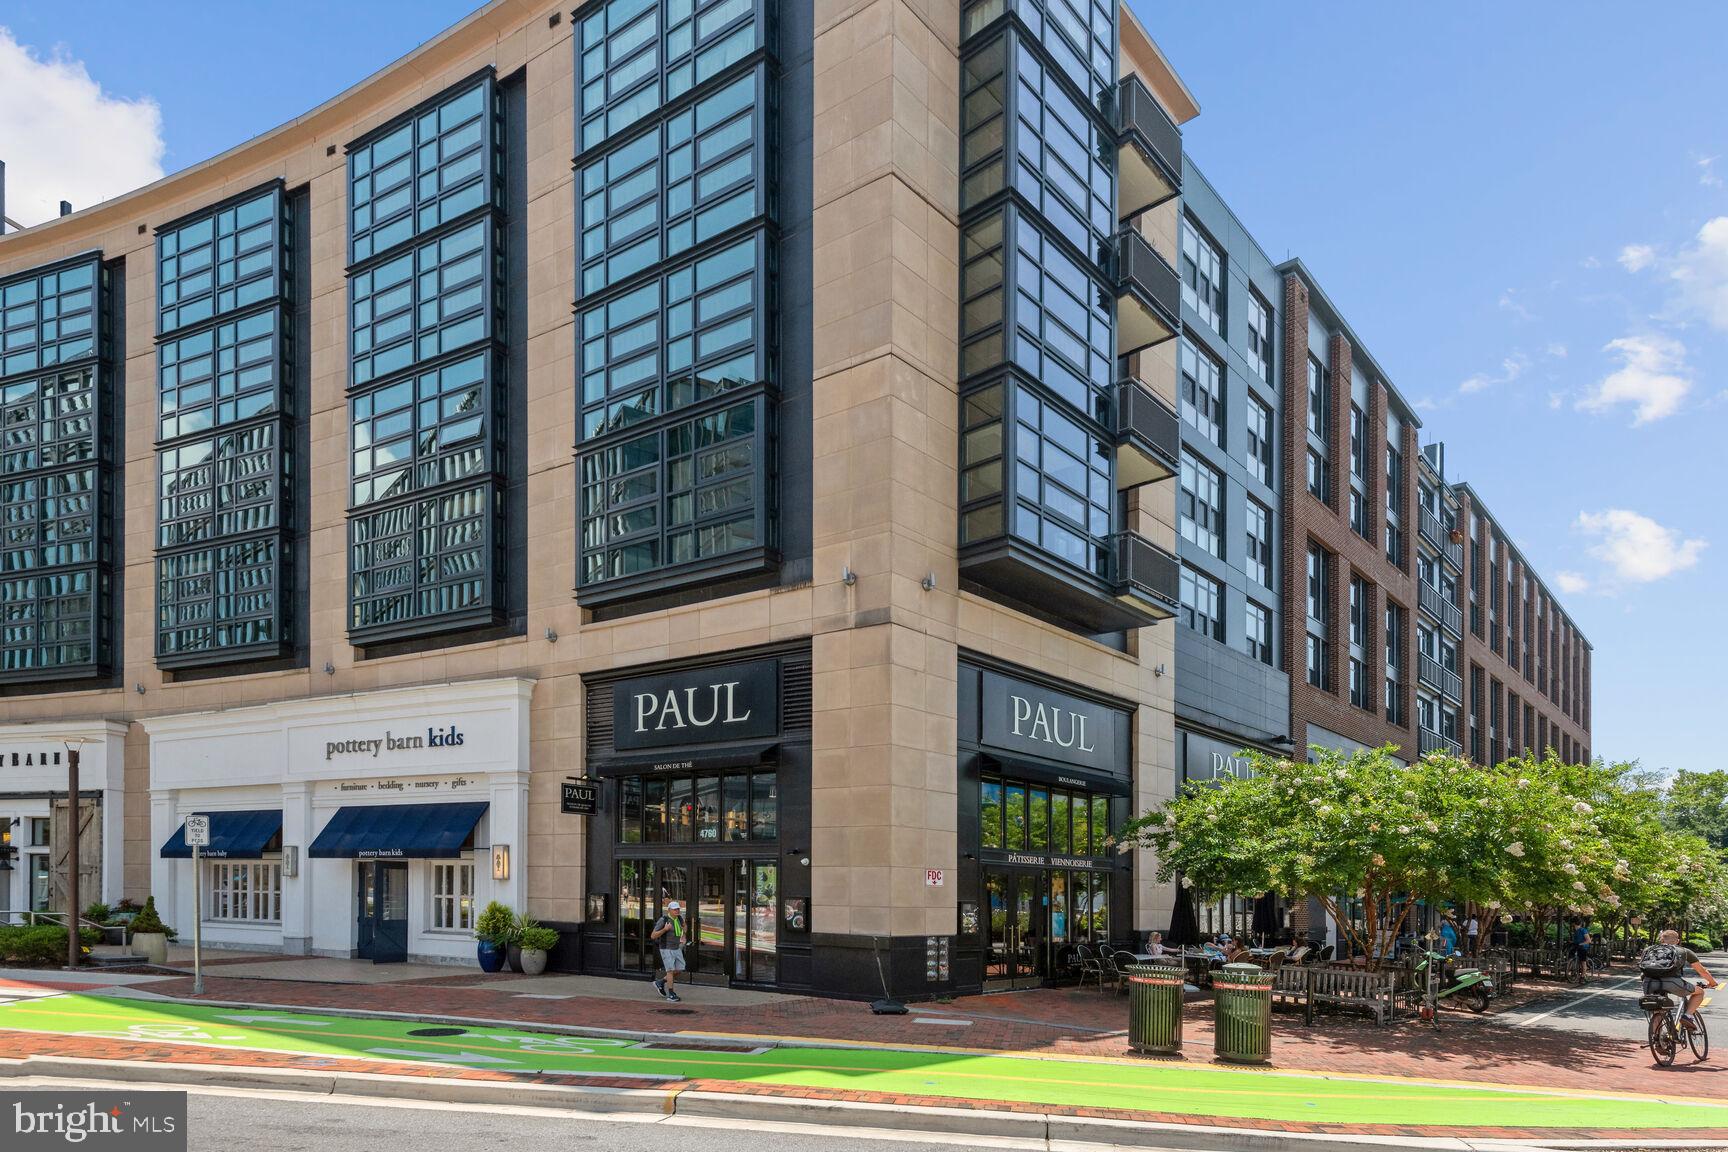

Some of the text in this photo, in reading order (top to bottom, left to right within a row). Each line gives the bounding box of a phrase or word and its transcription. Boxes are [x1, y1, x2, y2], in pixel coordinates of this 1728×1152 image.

[634, 681, 751, 733] PAUL
[1010, 695, 1095, 752] PAUL
[326, 725, 464, 760] pottery barn kids
[378, 781, 404, 791] bedding
[415, 781, 440, 790] nursery
[451, 777, 467, 789] gifts
[565, 787, 595, 800] PAUL
[358, 851, 377, 859] pottery
[391, 848, 403, 856] kids
[1050, 857, 1093, 868] VIENNOISERIE
[927, 870, 942, 880] FDC
